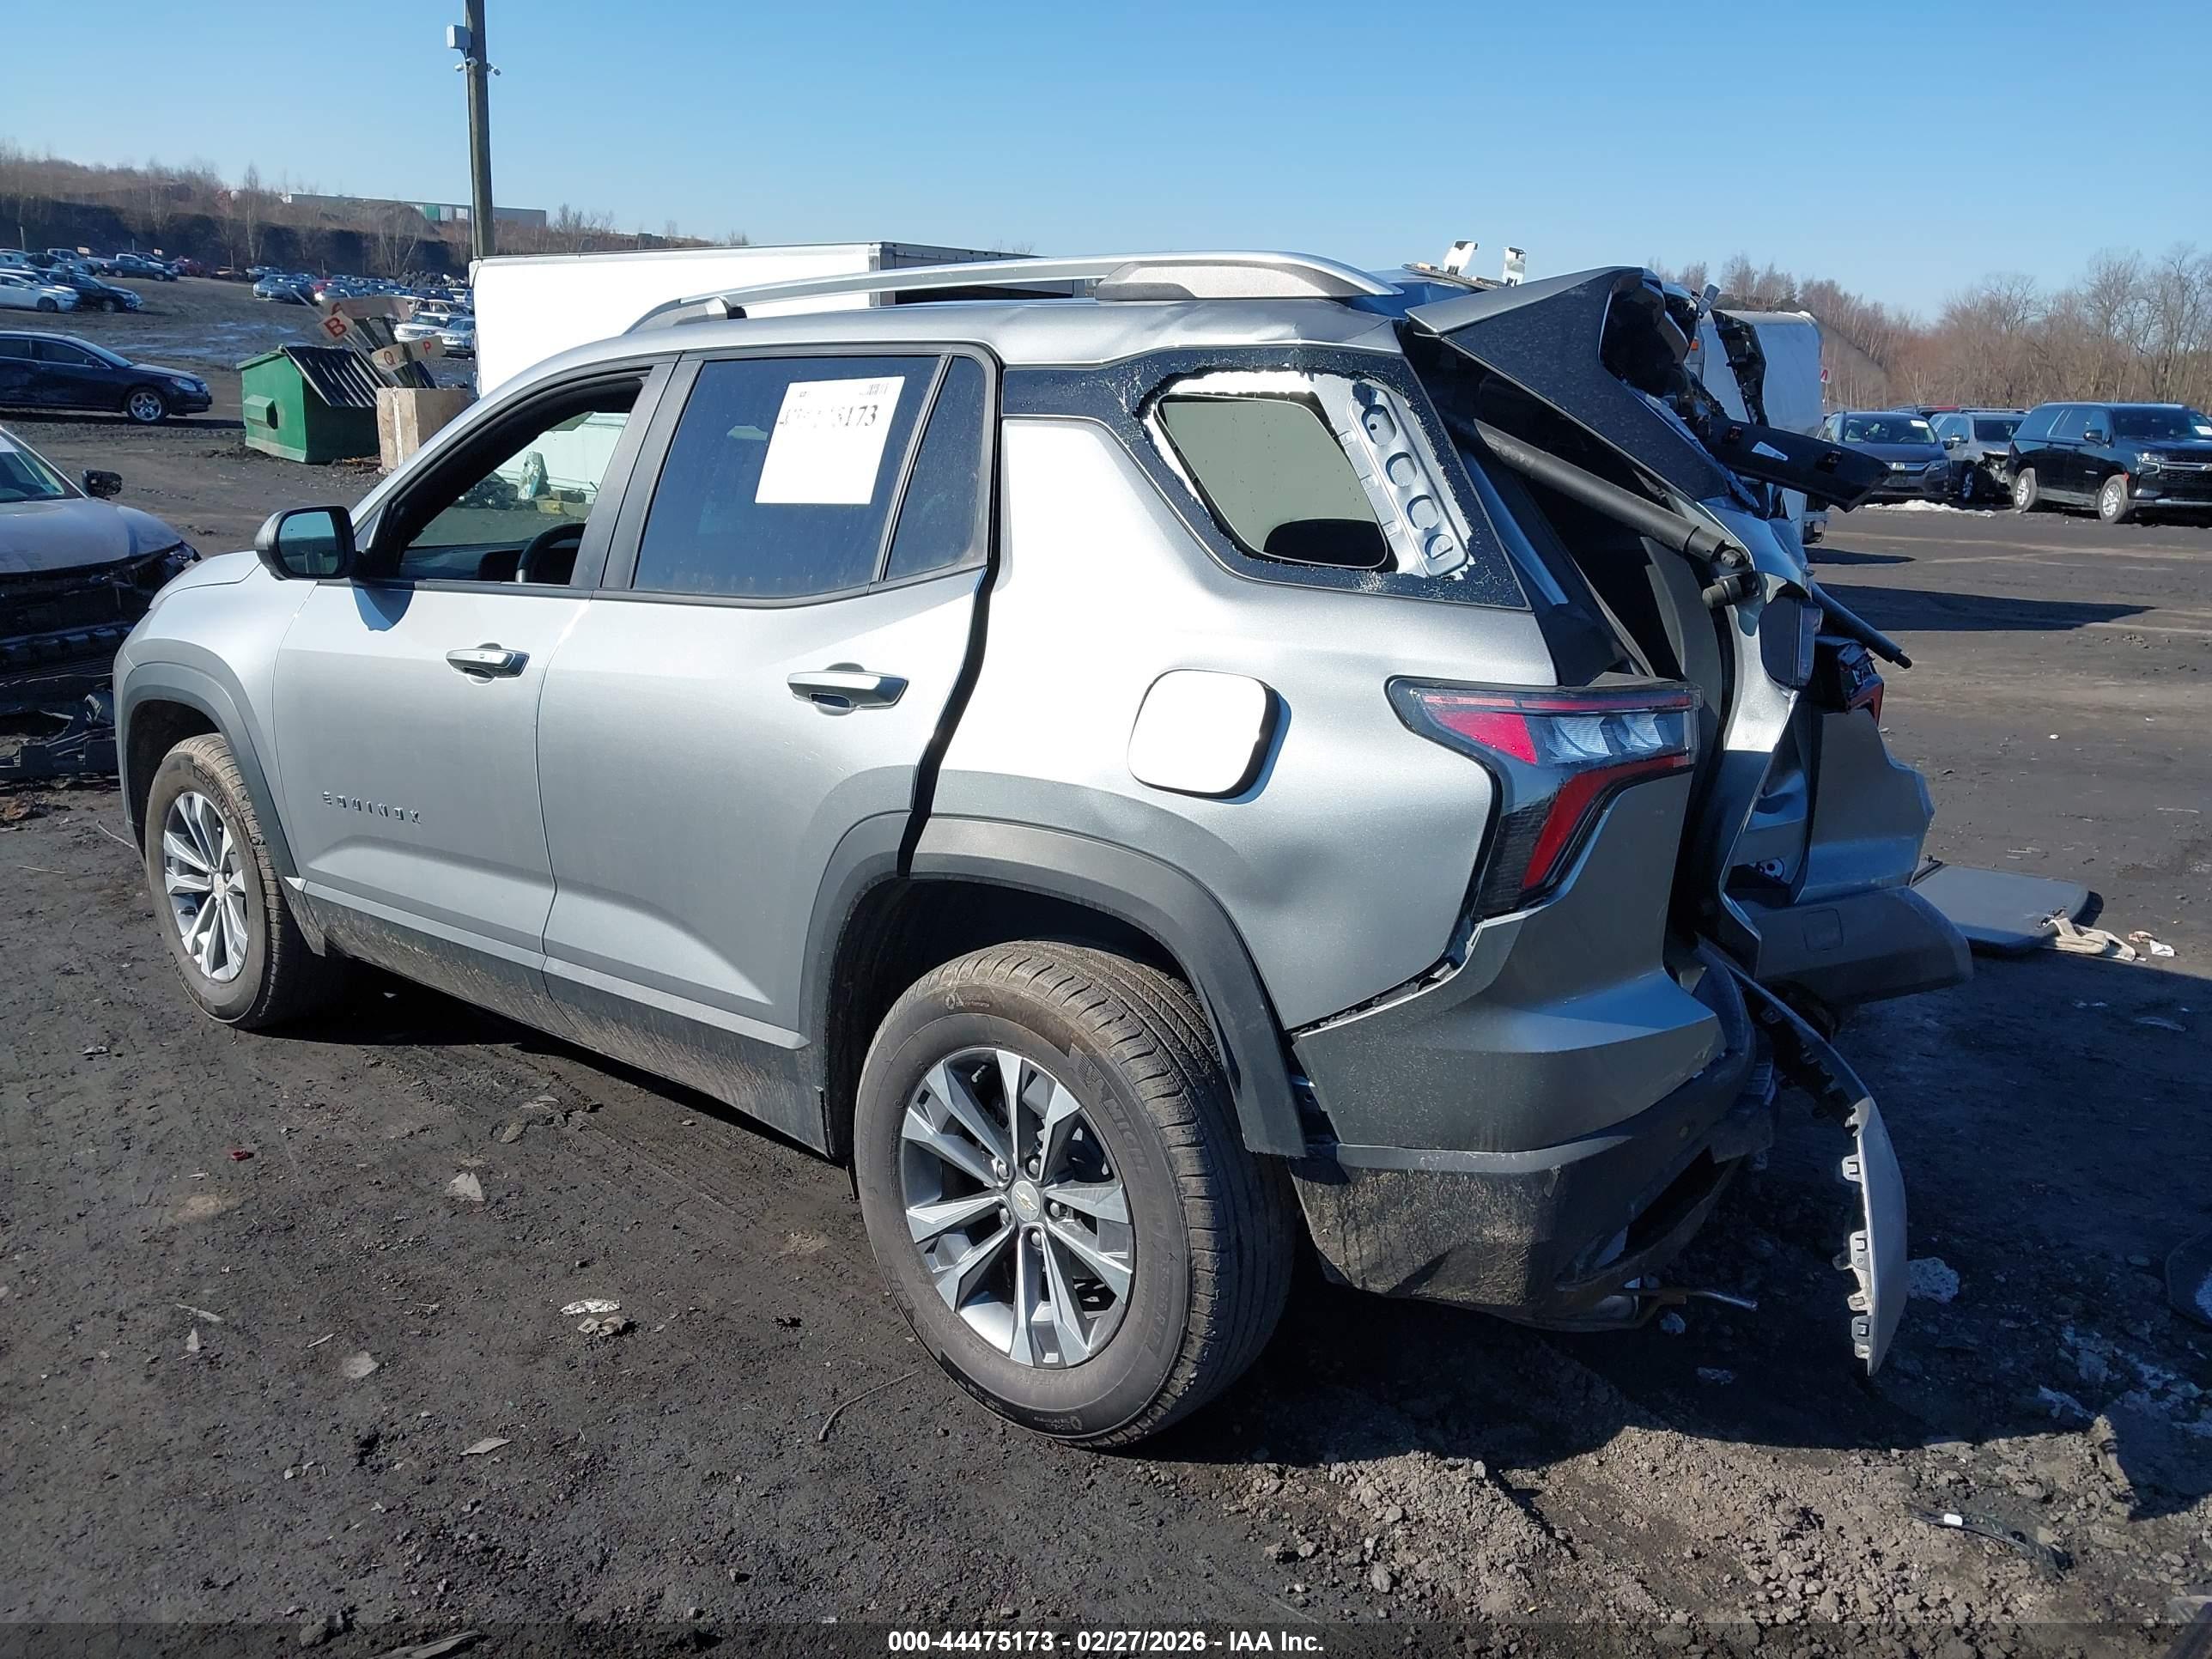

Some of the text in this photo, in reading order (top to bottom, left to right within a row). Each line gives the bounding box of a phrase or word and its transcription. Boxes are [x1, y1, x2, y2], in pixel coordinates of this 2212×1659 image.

[323, 317, 347, 337] B
[422, 341, 432, 356] P
[383, 350, 397, 367] Q
[322, 790, 422, 824] EQUINOX
